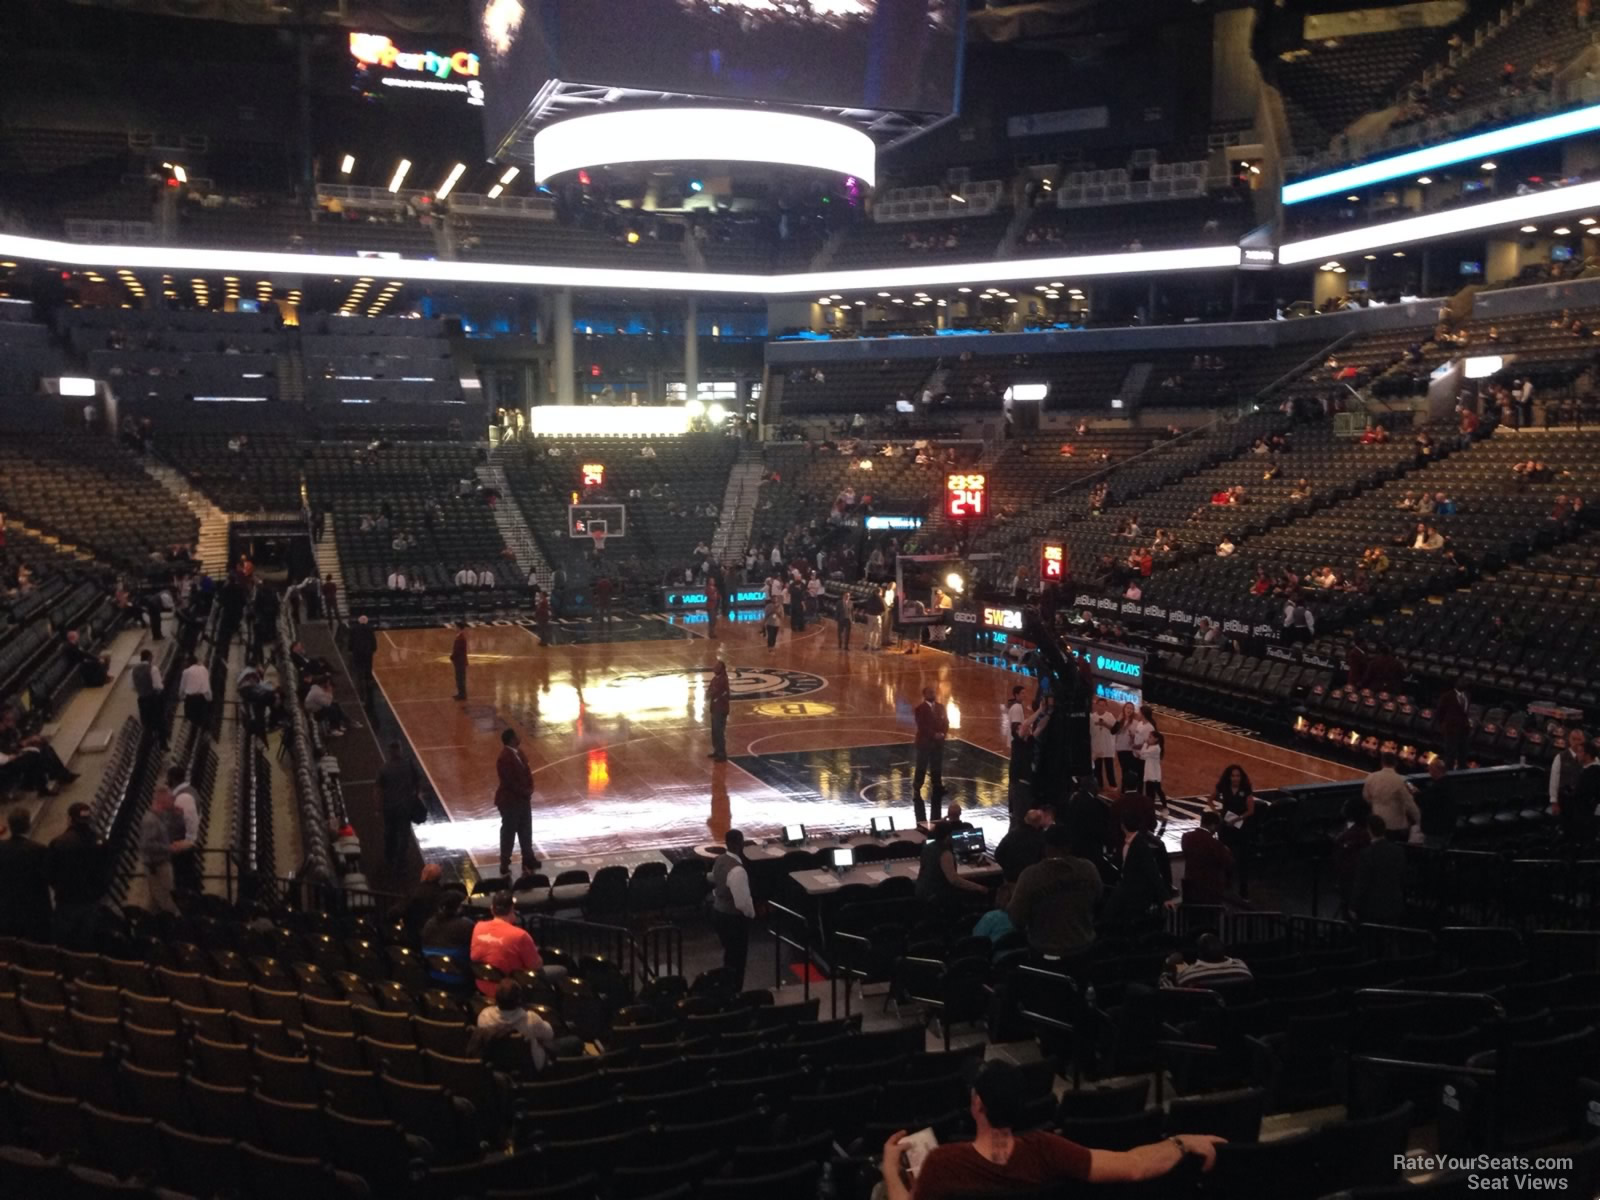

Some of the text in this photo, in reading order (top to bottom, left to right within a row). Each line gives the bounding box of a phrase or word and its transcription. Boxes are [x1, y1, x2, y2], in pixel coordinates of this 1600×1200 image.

[951, 490, 981, 514] 24
[954, 612, 976, 623] GEICO
[1104, 658, 1140, 677] BARCLAYS
